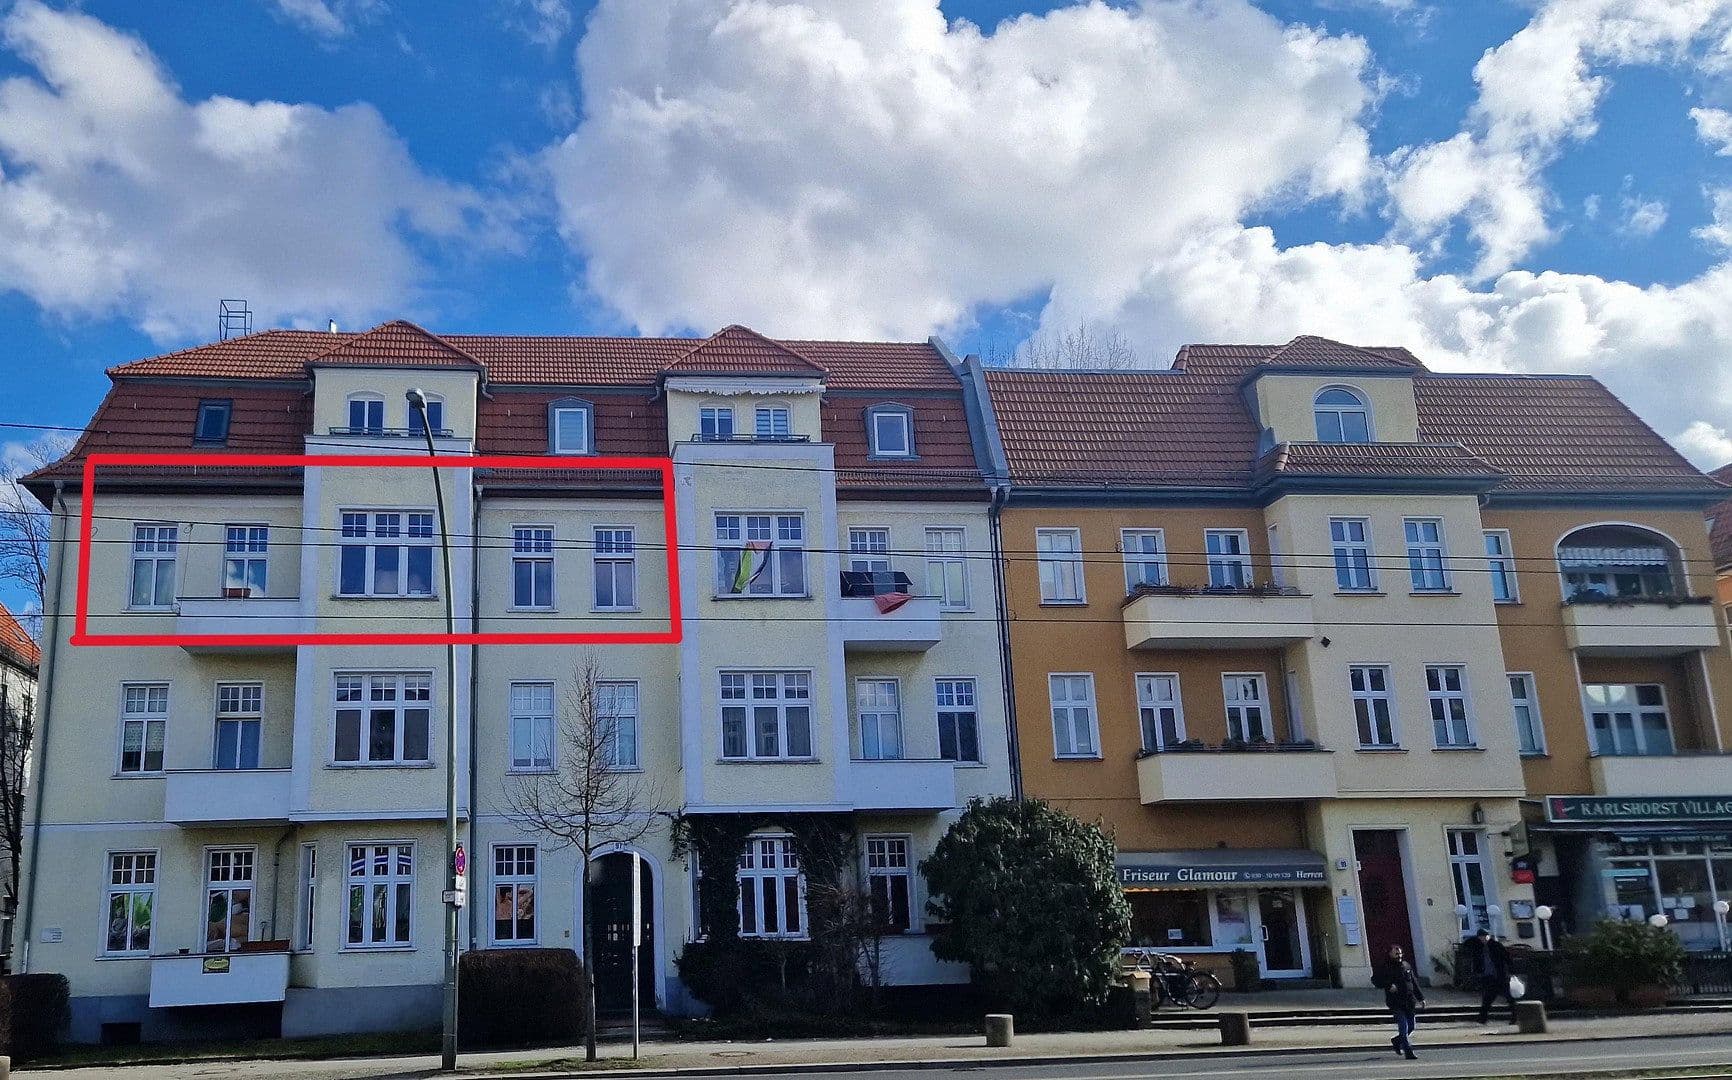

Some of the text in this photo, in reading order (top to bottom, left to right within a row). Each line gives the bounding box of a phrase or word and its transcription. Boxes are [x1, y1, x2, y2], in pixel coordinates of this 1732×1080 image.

[1581, 802, 1678, 815] KARLSHORST
[1123, 869, 1170, 881] Friseur
[1177, 868, 1237, 881] Glamour
[1295, 870, 1324, 879] Herren
